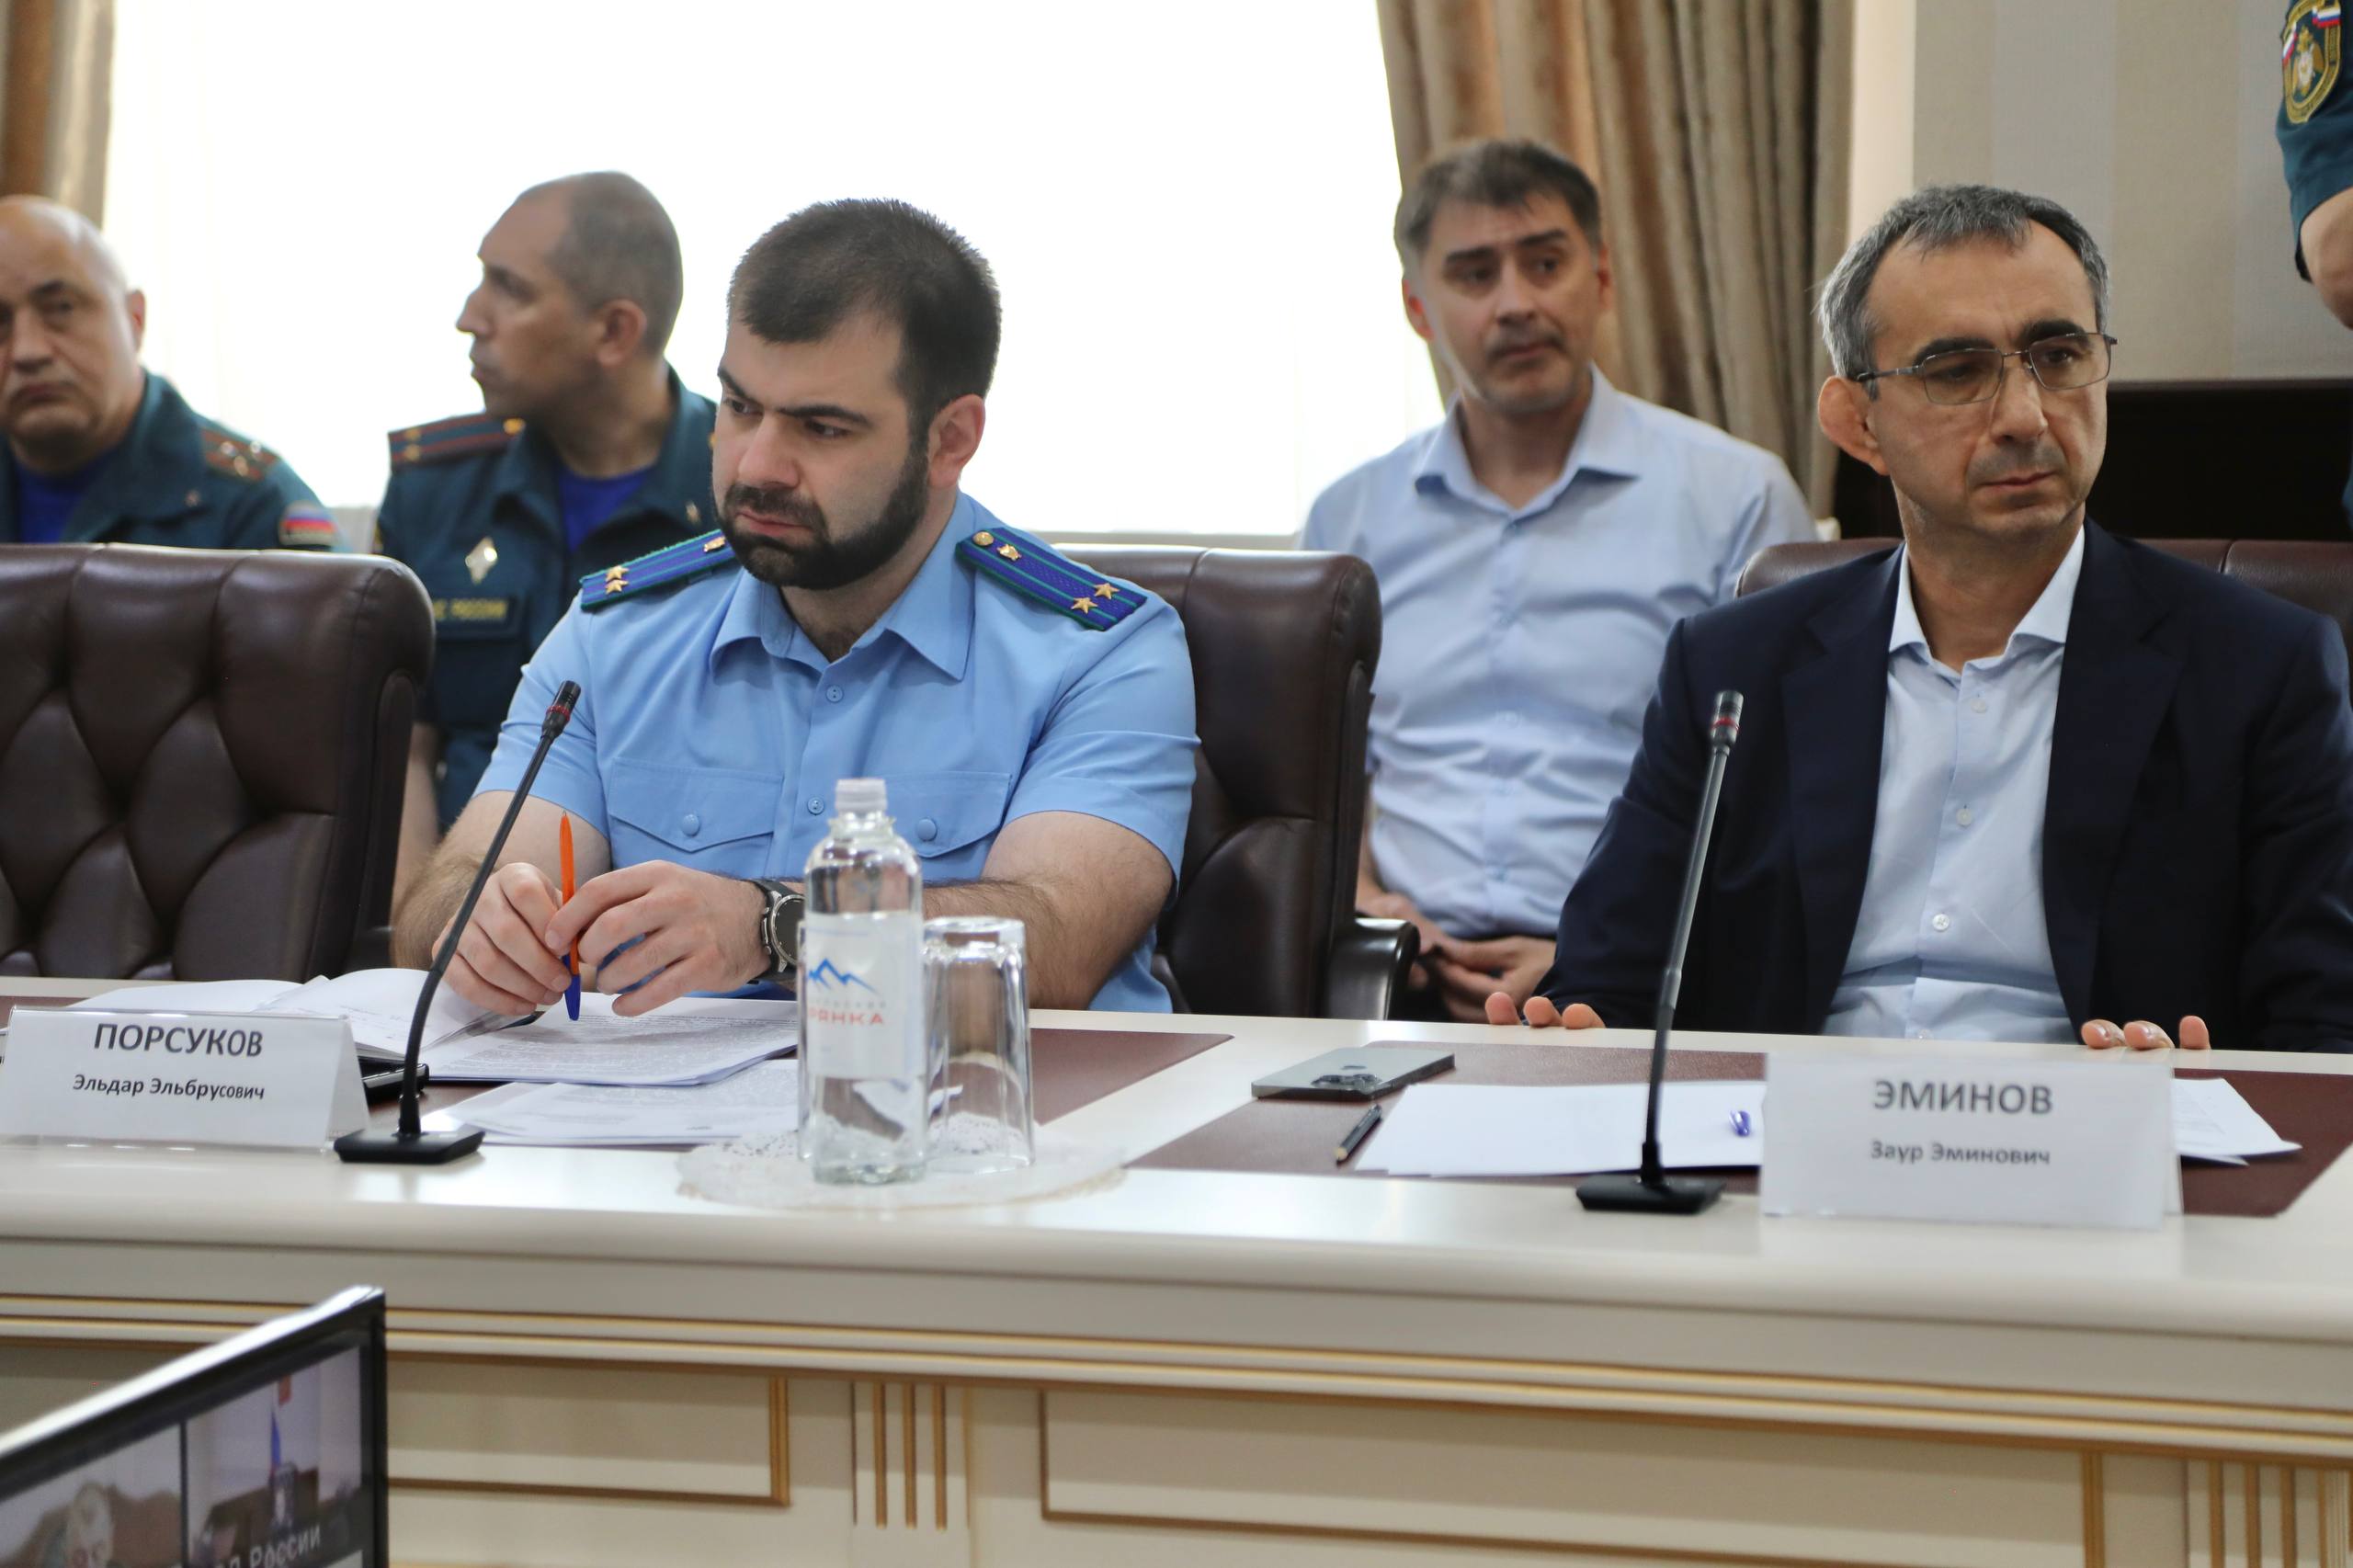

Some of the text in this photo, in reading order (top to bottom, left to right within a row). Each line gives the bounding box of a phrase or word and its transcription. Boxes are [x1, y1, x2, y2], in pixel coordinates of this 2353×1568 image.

[94, 1023, 263, 1057] ПОРСУКОВ
[73, 1074, 265, 1101] Эльдар Эльбрусович
[1873, 1080, 2052, 1115] ЭМИНОВ
[1870, 1141, 2051, 1165] Заур Эминович
[249, 1524, 321, 1568] России
